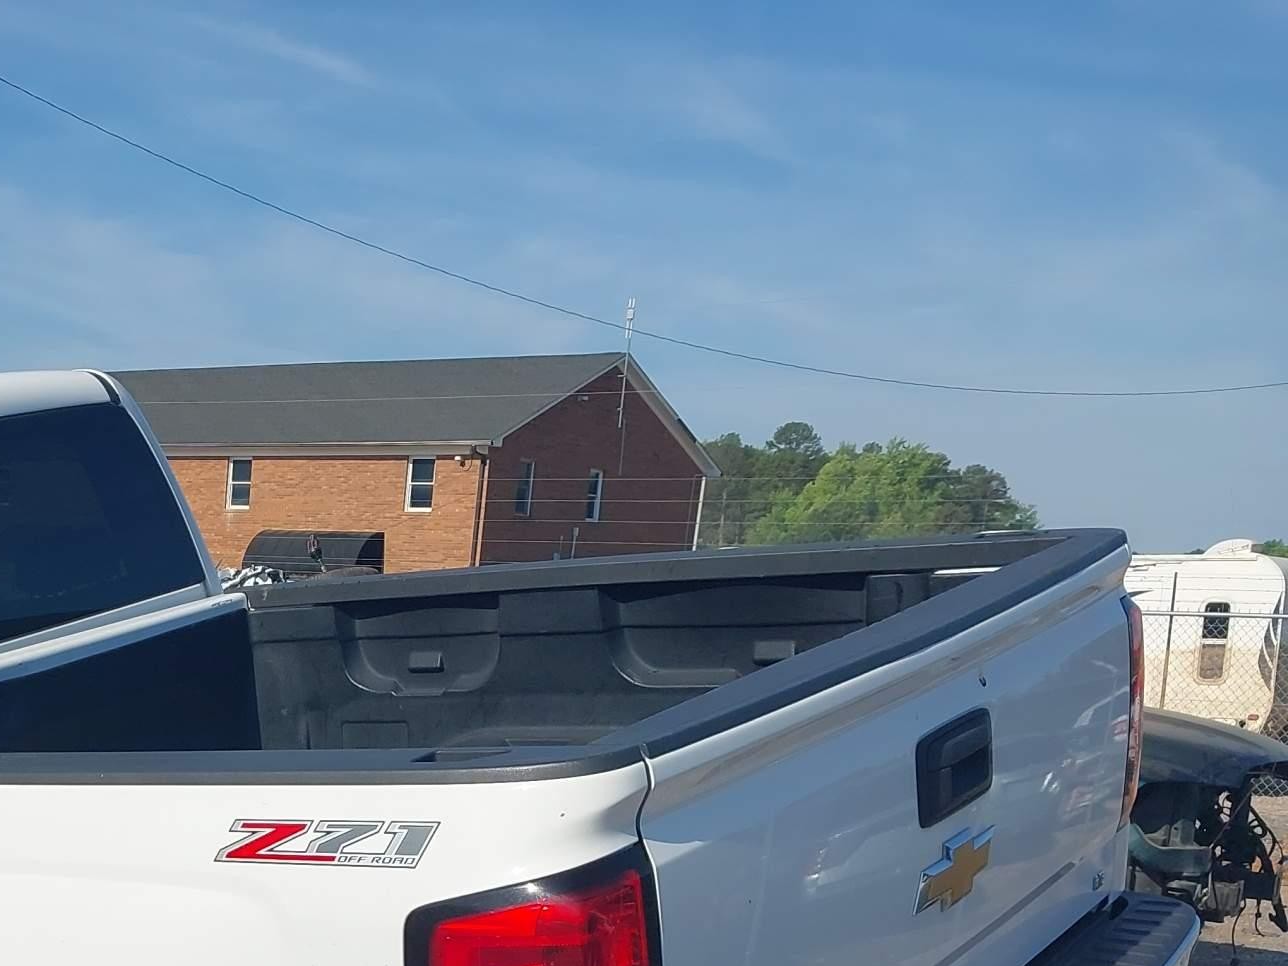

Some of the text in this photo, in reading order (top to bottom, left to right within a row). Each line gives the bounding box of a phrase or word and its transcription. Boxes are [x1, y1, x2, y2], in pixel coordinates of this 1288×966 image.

[213, 819, 440, 868] Z71
[337, 855, 416, 865] OFF ROAD
